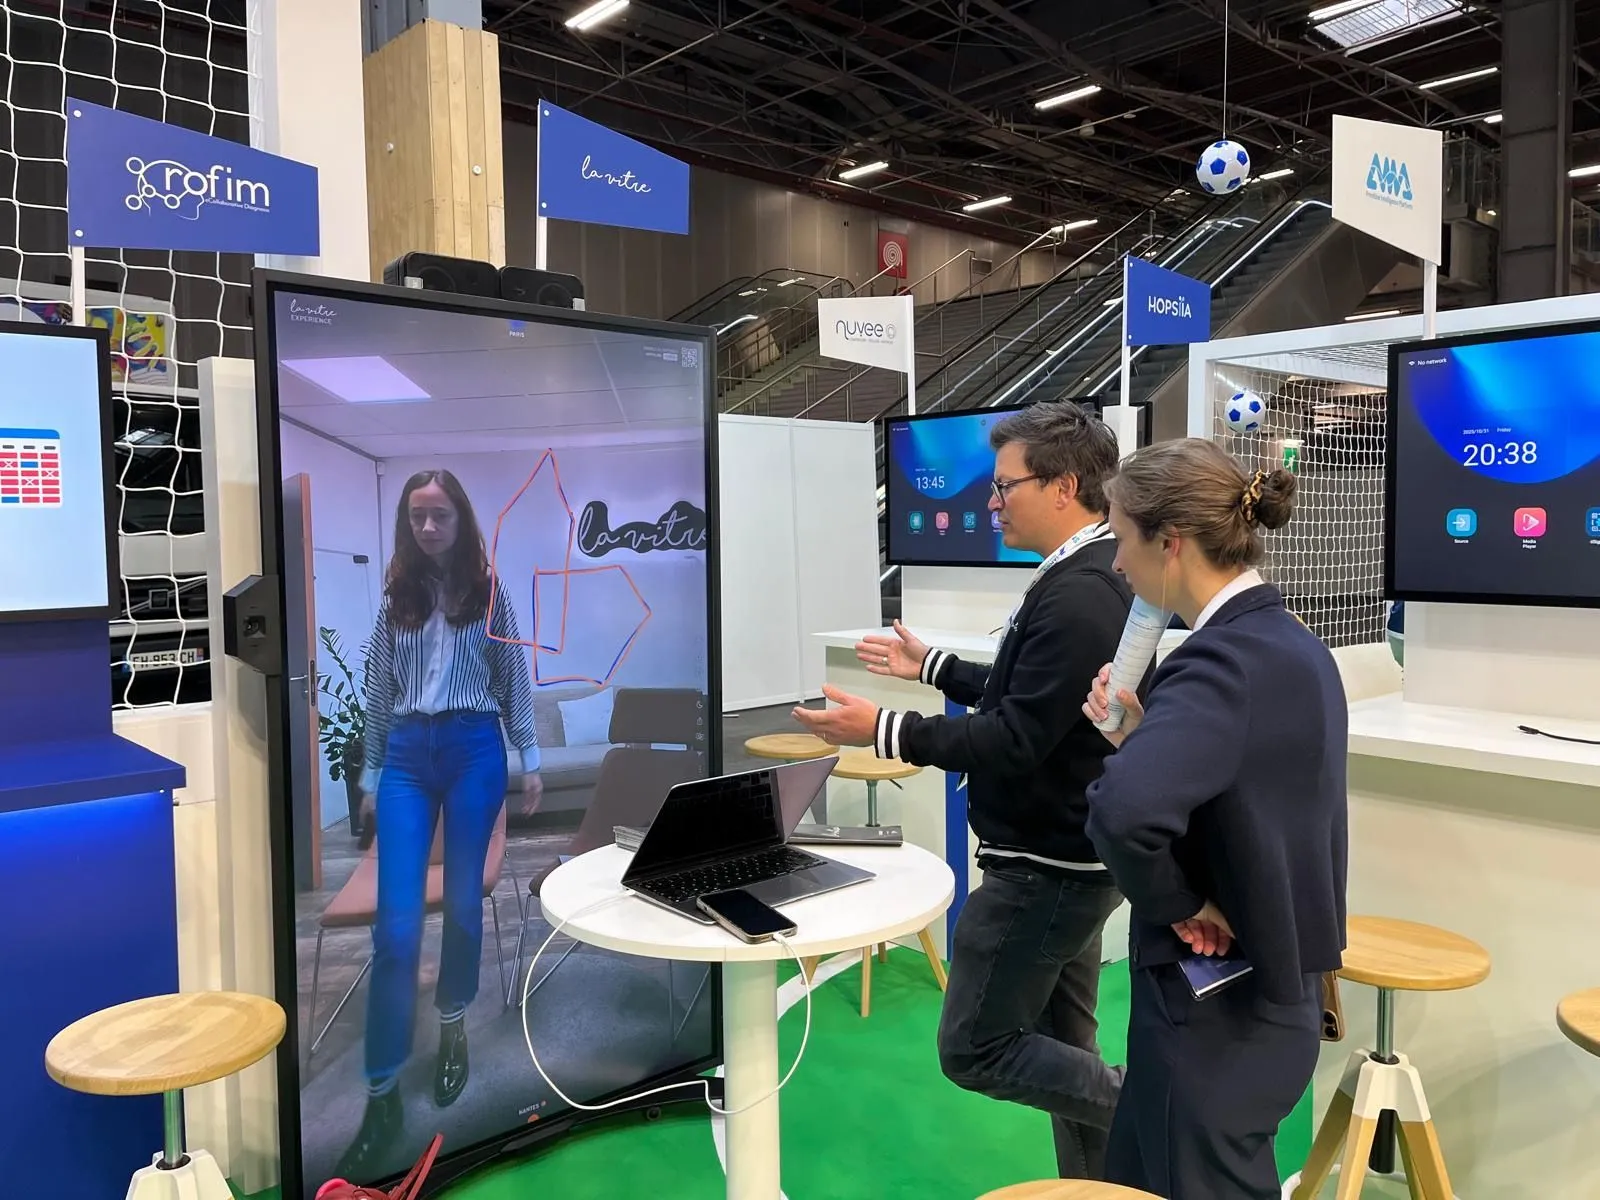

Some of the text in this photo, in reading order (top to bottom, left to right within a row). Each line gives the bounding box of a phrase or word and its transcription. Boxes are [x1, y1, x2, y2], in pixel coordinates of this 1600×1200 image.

[581, 155, 652, 193] la vitre
[165, 164, 270, 207] rofim
[290, 298, 305, 313] la
[290, 314, 333, 325] EXPERIENCE
[1426, 357, 1447, 365] network
[1463, 441, 1538, 467] 20:38
[915, 475, 945, 490] 13:45
[579, 506, 621, 554] la
